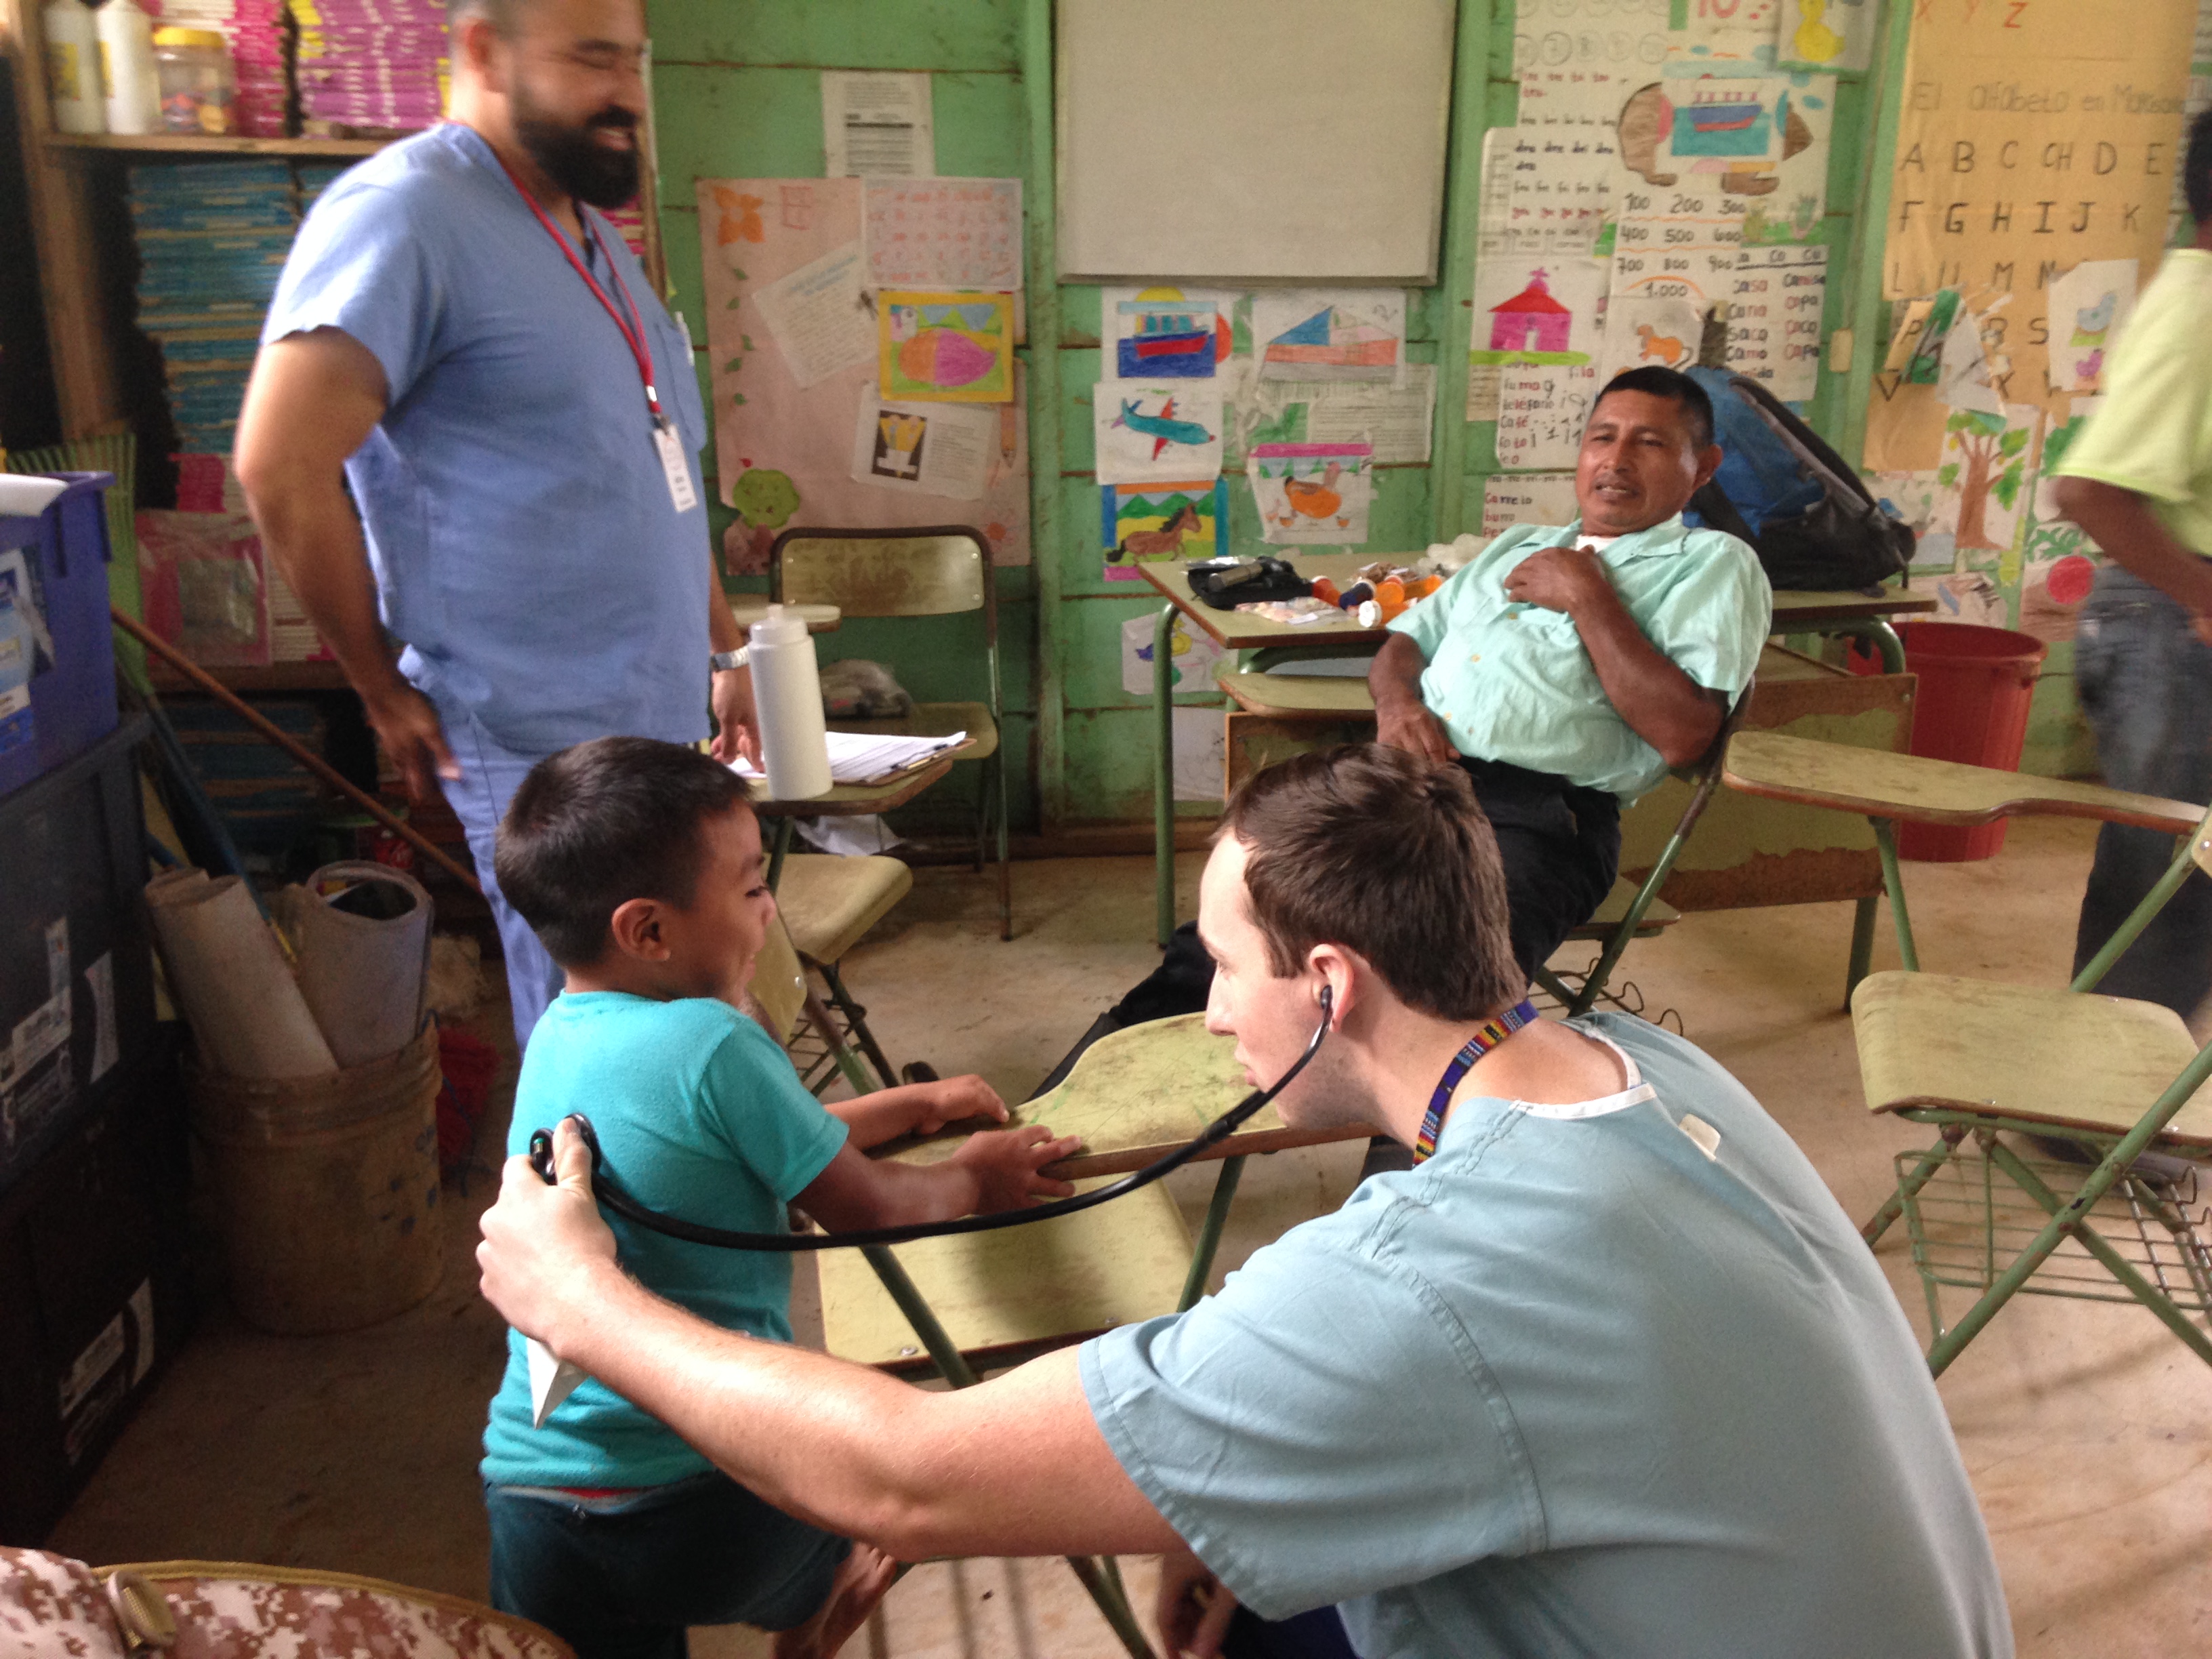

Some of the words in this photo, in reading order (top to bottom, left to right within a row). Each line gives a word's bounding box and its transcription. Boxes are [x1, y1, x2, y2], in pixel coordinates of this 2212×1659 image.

[2004, 2, 2028, 28] Z
[1899, 142, 1926, 173] A
[1952, 141, 1975, 173] B
[1999, 140, 2020, 169] C
[2042, 141, 2074, 170] CH
[2093, 142, 2118, 176] D
[2146, 142, 2166, 175] E
[1624, 192, 1651, 211] 100
[1669, 194, 1704, 213] 200
[1718, 199, 1746, 215] 300
[1898, 201, 1925, 232] F
[1945, 201, 1969, 233] G
[1990, 201, 2013, 232] H
[2033, 201, 2057, 233] I
[2070, 201, 2097, 233] J
[2123, 203, 2141, 232] K
[1620, 224, 1650, 242] 400
[1664, 228, 1694, 243] 500
[1713, 228, 1742, 242] 600
[1617, 256, 1644, 274] 700
[1663, 258, 1689, 271] 800
[1708, 255, 1734, 272] 900
[1992, 262, 2013, 291] M
[1645, 282, 1688, 298] 1.000
[2028, 316, 2049, 345] S
[1875, 372, 1902, 402] V
